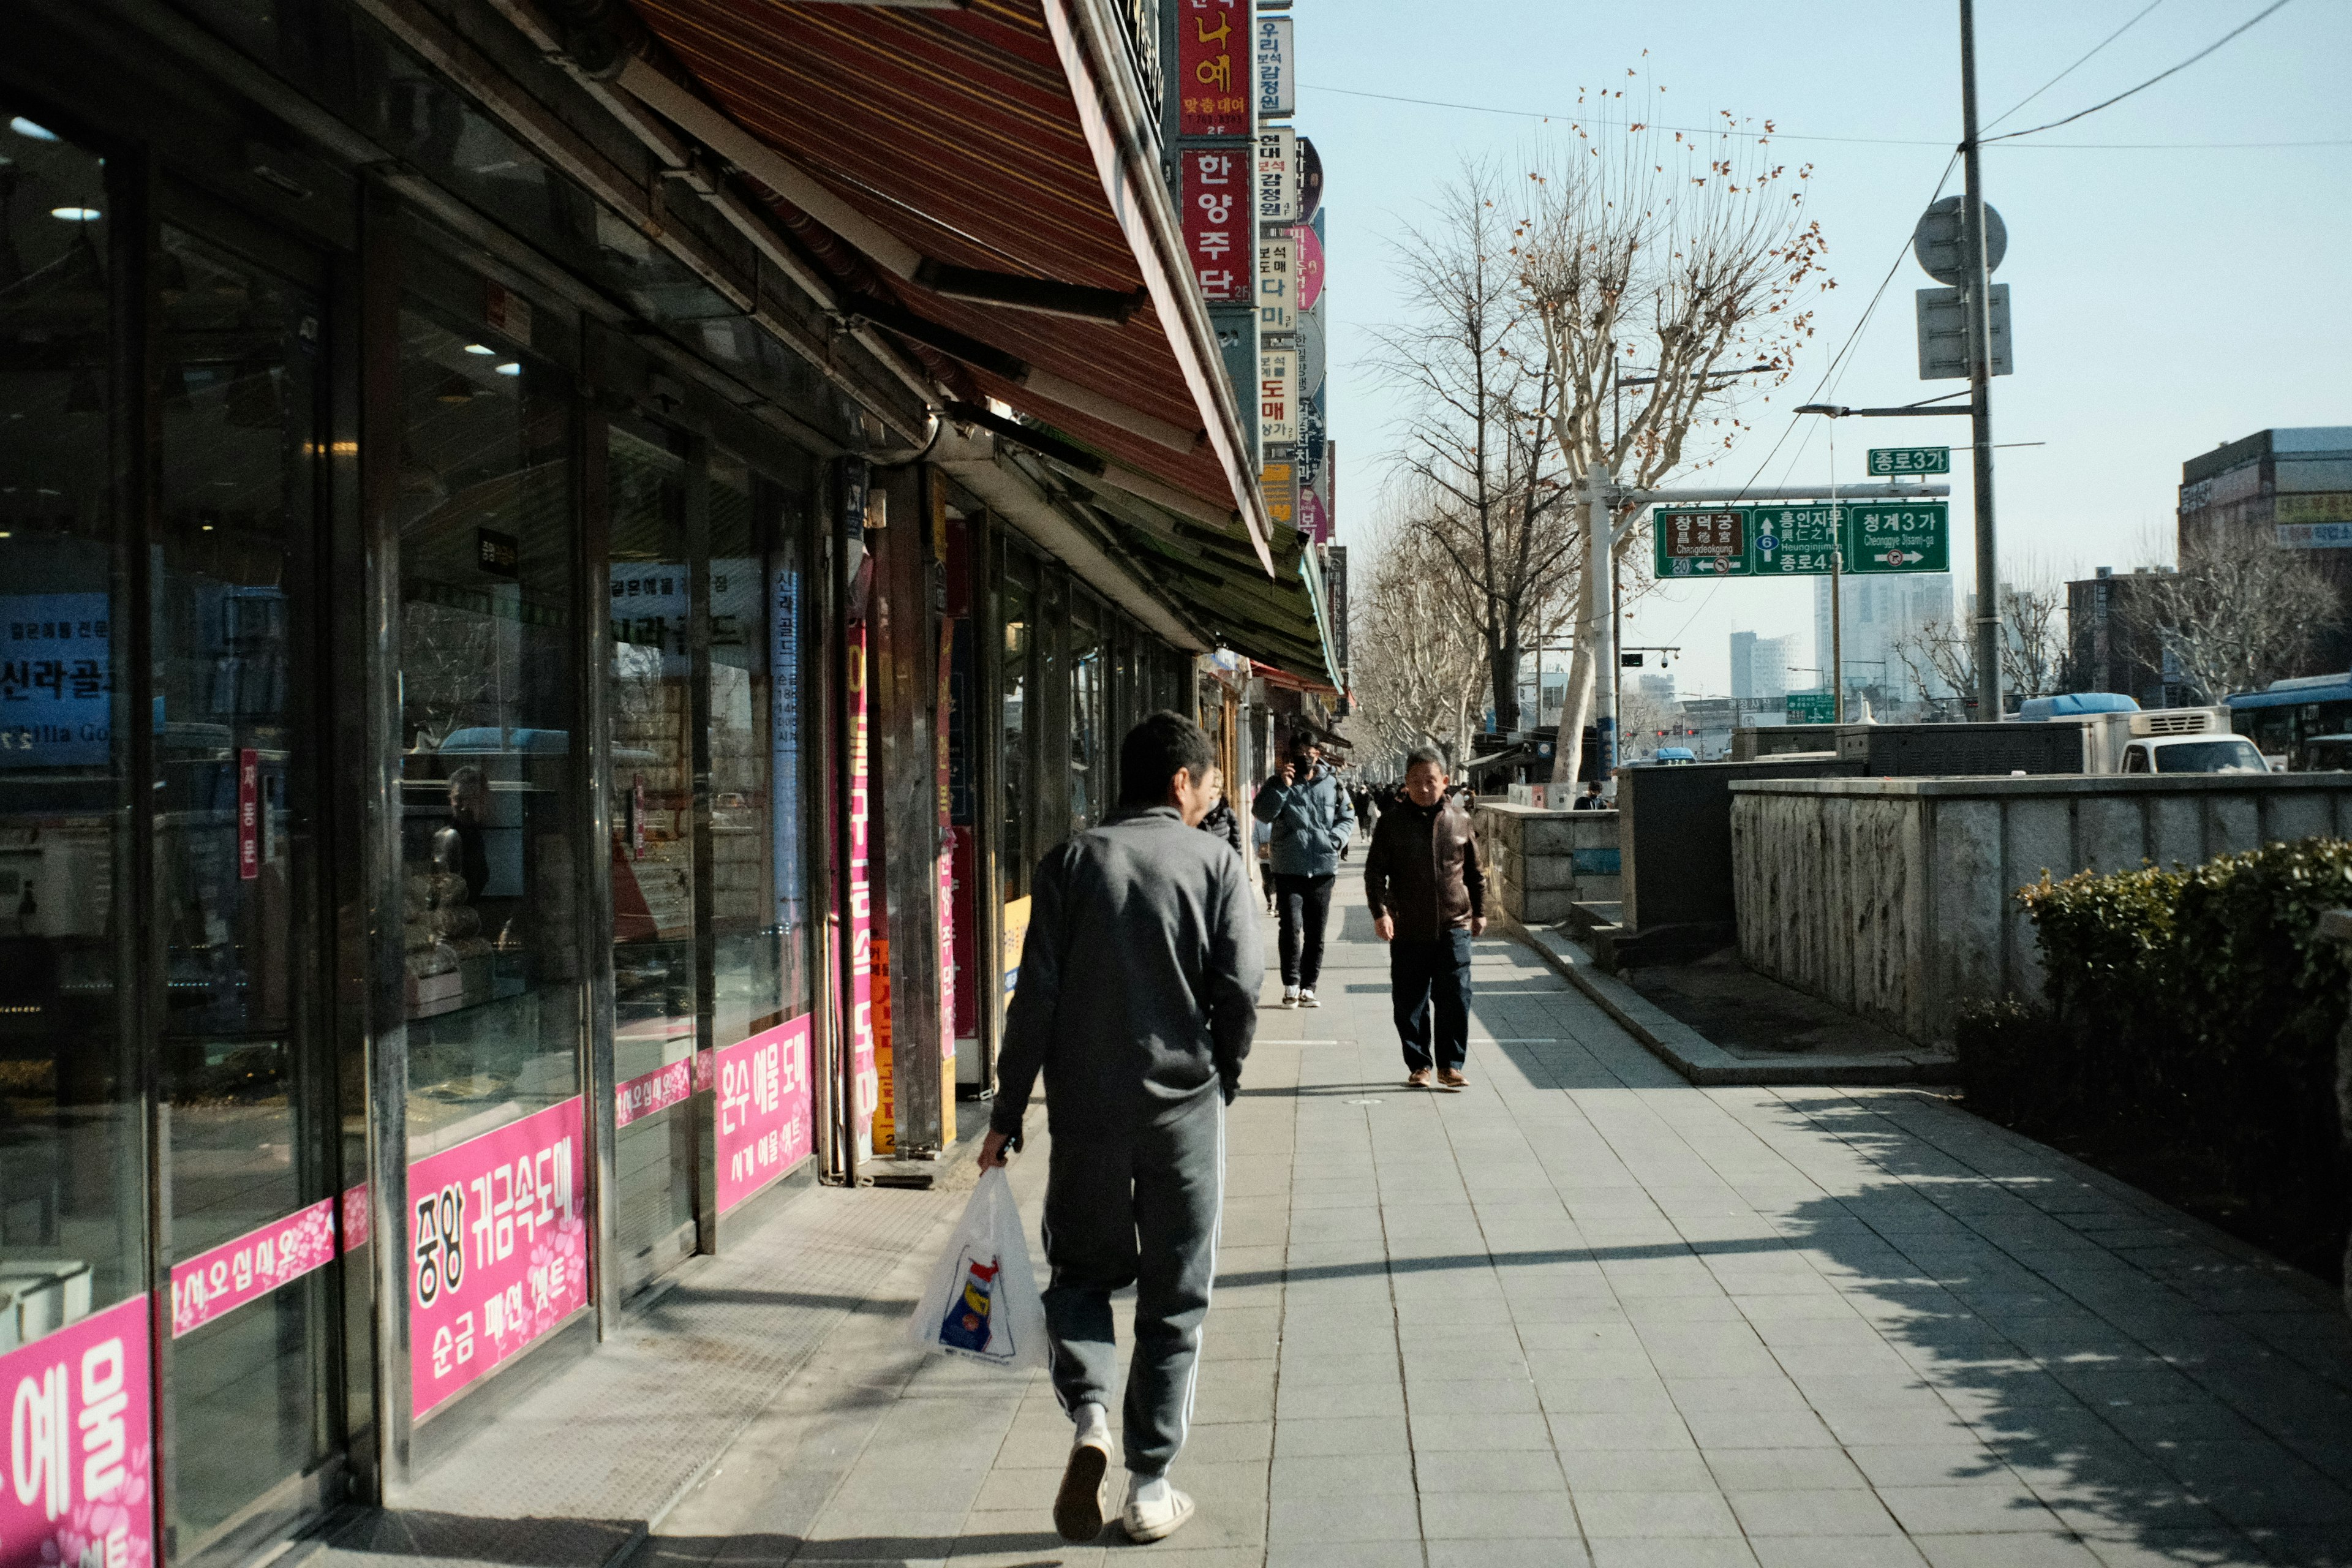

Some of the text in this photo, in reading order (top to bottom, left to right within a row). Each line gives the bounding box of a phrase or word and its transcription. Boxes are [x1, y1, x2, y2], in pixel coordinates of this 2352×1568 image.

[1195, 10, 1232, 93] 나예
[1207, 126, 1226, 135] 2F
[1259, 135, 1285, 216] 현대 보석 감정원
[1198, 156, 1233, 300] 한양주단
[1260, 247, 1286, 258] 보석
[1260, 261, 1286, 273] 도매
[1235, 285, 1250, 299] 2F
[1262, 279, 1286, 325] 다미
[1261, 356, 1285, 366] 보석
[1262, 380, 1284, 421] 도매
[1262, 423, 1286, 437] 상가
[1875, 451, 1944, 471] 종로3가
[1675, 514, 1733, 531] 창덕궁
[1779, 510, 1844, 529] 흥인지문
[1863, 512, 1936, 532] 청계3가
[1676, 545, 1733, 556] Changdeokgung
[1762, 537, 1773, 548] 6
[0, 659, 115, 700] 신라골
[722, 1060, 750, 1136] 혼수
[753, 1042, 778, 1115] 예물
[782, 1031, 806, 1094] 도매
[731, 1116, 801, 1182] 시계 예물 셋트
[415, 1135, 573, 1309] 중앙 귀금속도매
[432, 1256, 567, 1379] 순금 패션 셋트
[10, 1337, 128, 1523] 예물
